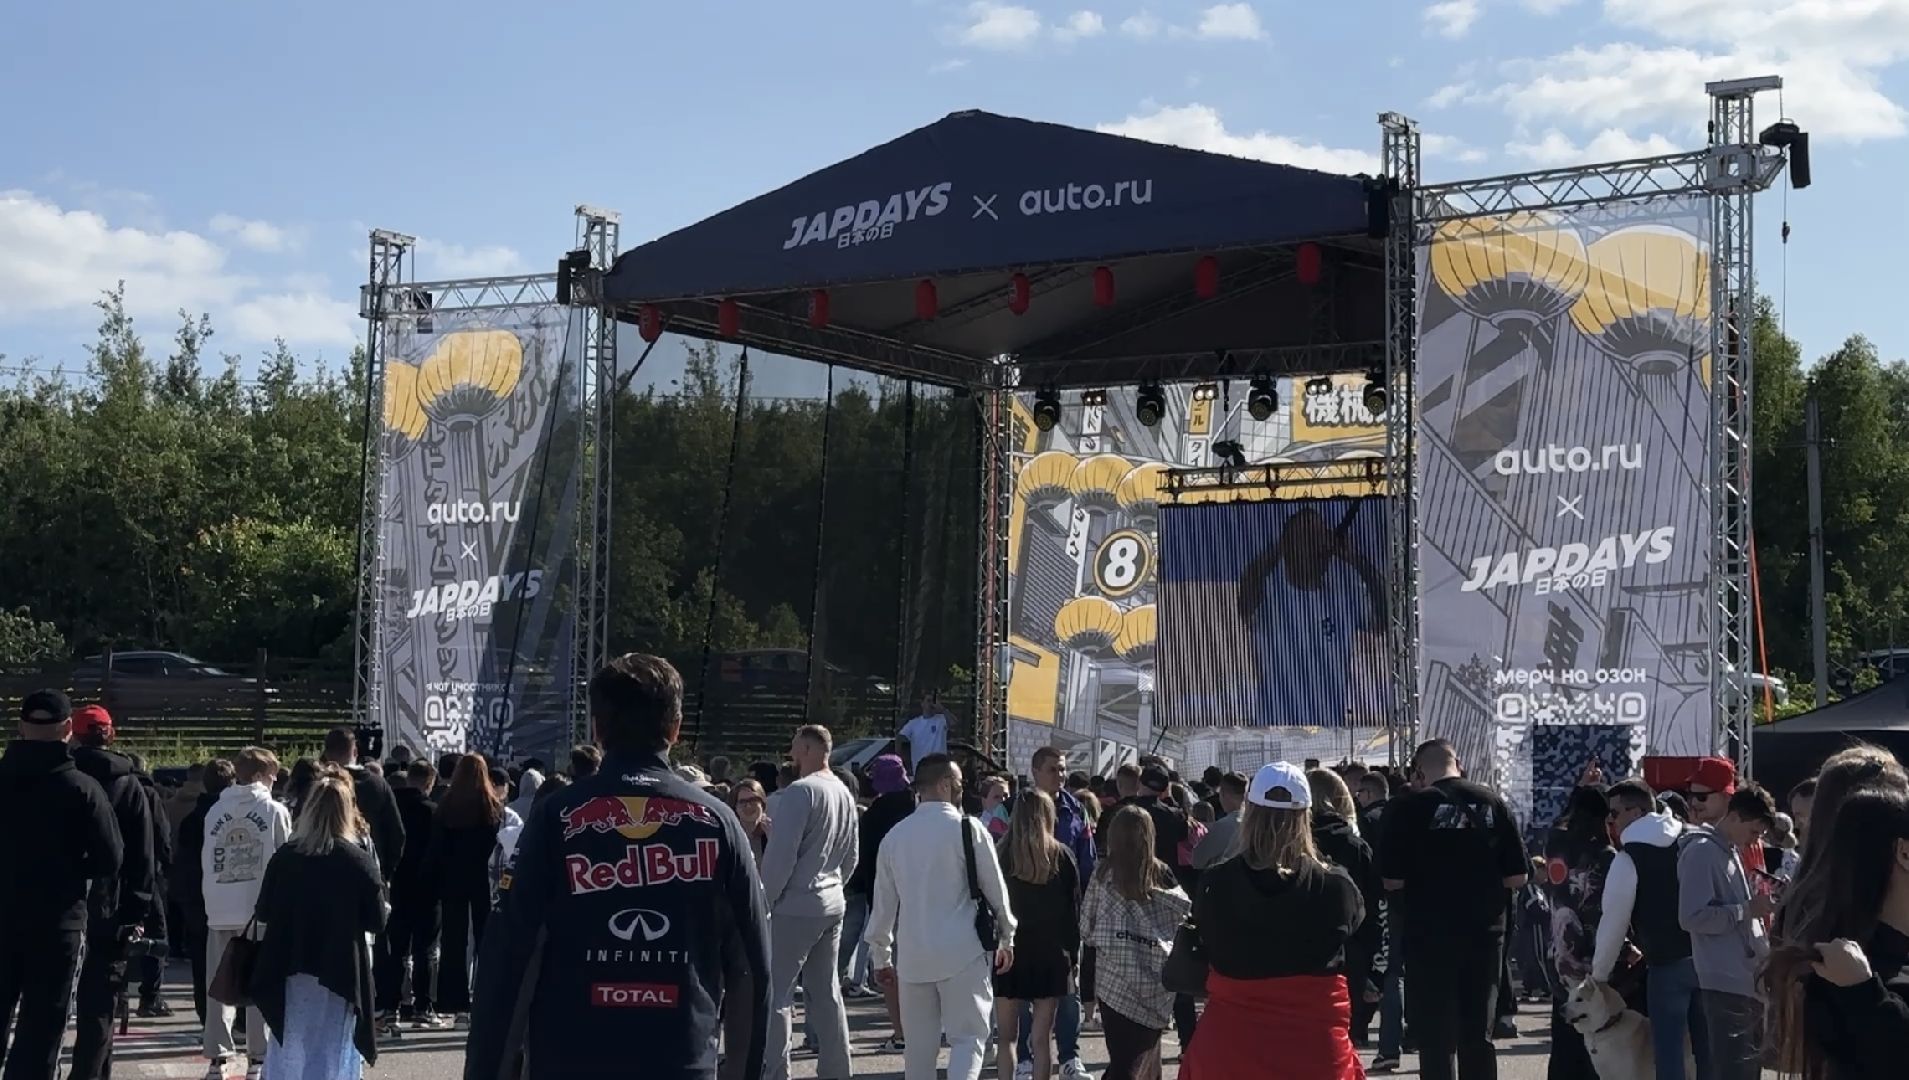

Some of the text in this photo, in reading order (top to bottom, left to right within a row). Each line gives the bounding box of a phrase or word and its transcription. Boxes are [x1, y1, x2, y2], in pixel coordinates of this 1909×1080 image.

[784, 182, 951, 249] JAPDAYS
[1019, 179, 1152, 215] auto.ru
[837, 222, 895, 249] 日本の日
[1495, 443, 1642, 475] auto.ru
[427, 499, 520, 524] auto.ru
[1104, 538, 1138, 587] 8
[1461, 527, 1675, 592] JAPDAYS
[407, 569, 543, 618] JAPDAYS
[1535, 570, 1607, 596] 日本の日
[1496, 668, 1646, 689] мерч на озон
[566, 838, 720, 895] Red Bull
[586, 949, 688, 963] INFINITI
[598, 987, 672, 1003] TOTAL
